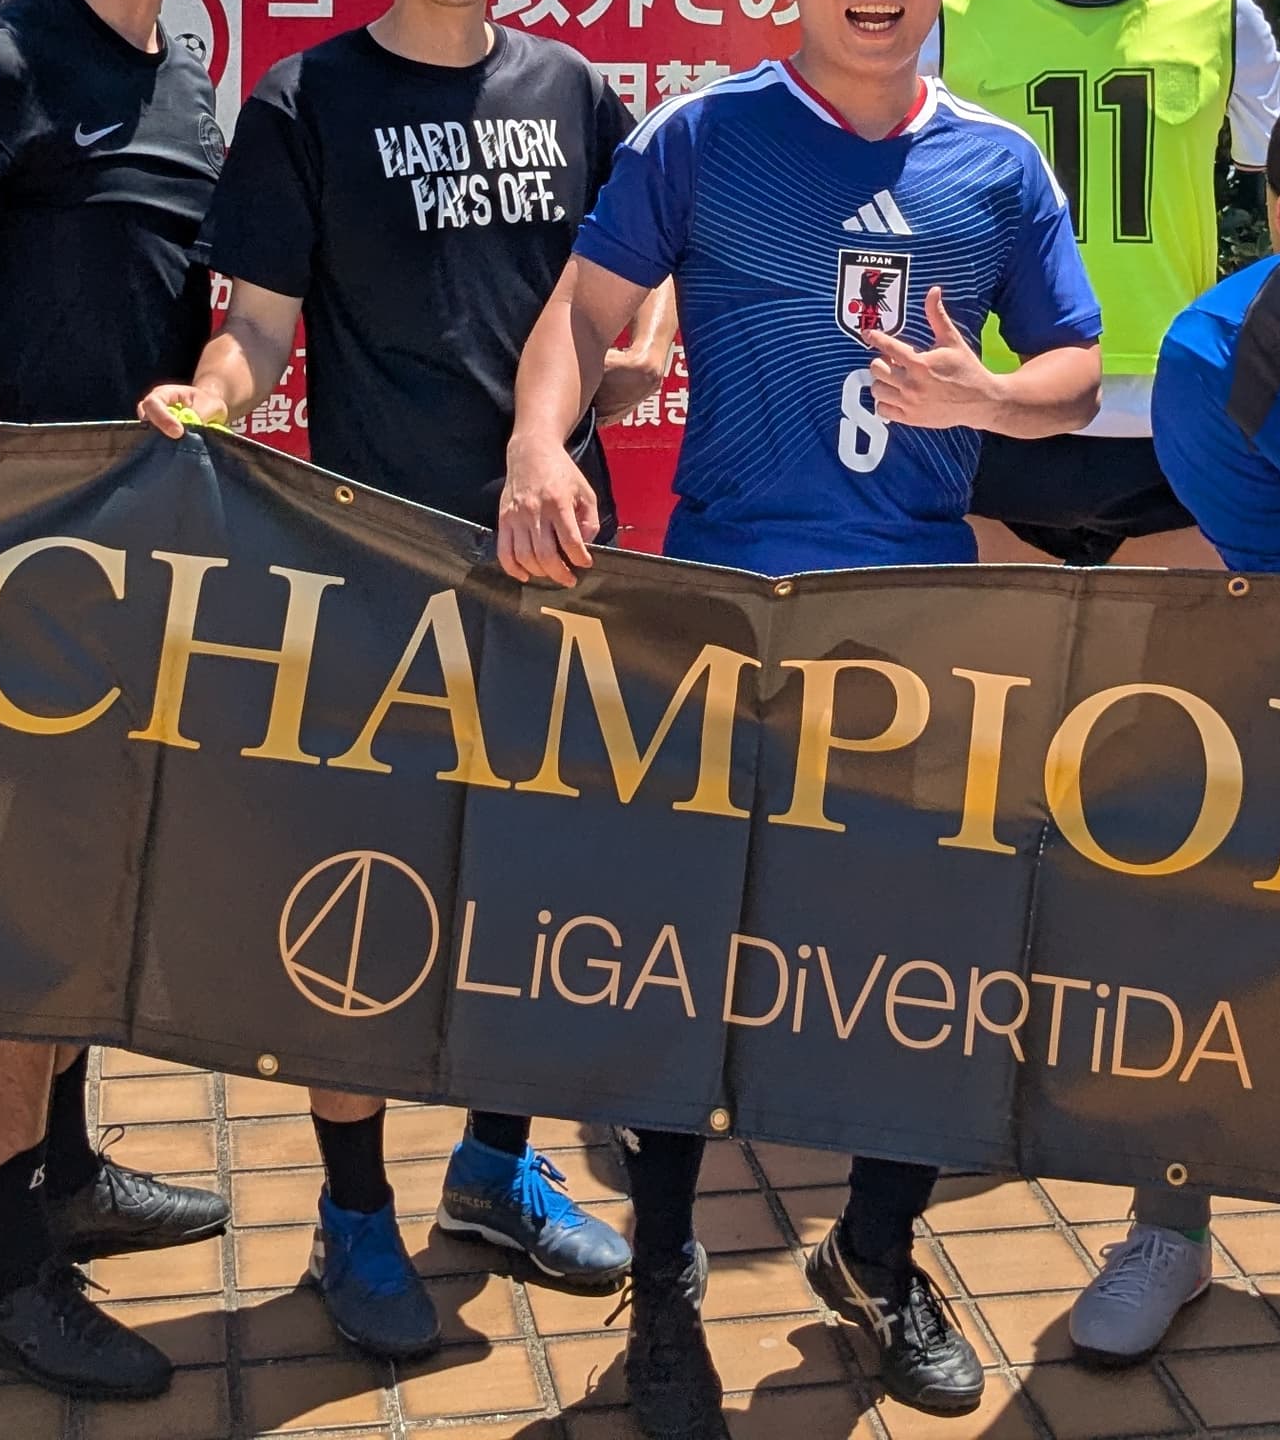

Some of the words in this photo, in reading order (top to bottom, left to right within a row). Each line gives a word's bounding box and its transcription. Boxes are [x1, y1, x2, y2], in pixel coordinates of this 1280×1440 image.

[374, 121, 471, 179] HARD
[473, 118, 568, 170] WORK
[1026, 68, 1155, 244] 11
[411, 173, 493, 232] PAYS
[855, 254, 893, 266] JAPAN
[854, 315, 885, 331] JFA
[838, 368, 889, 474] 8
